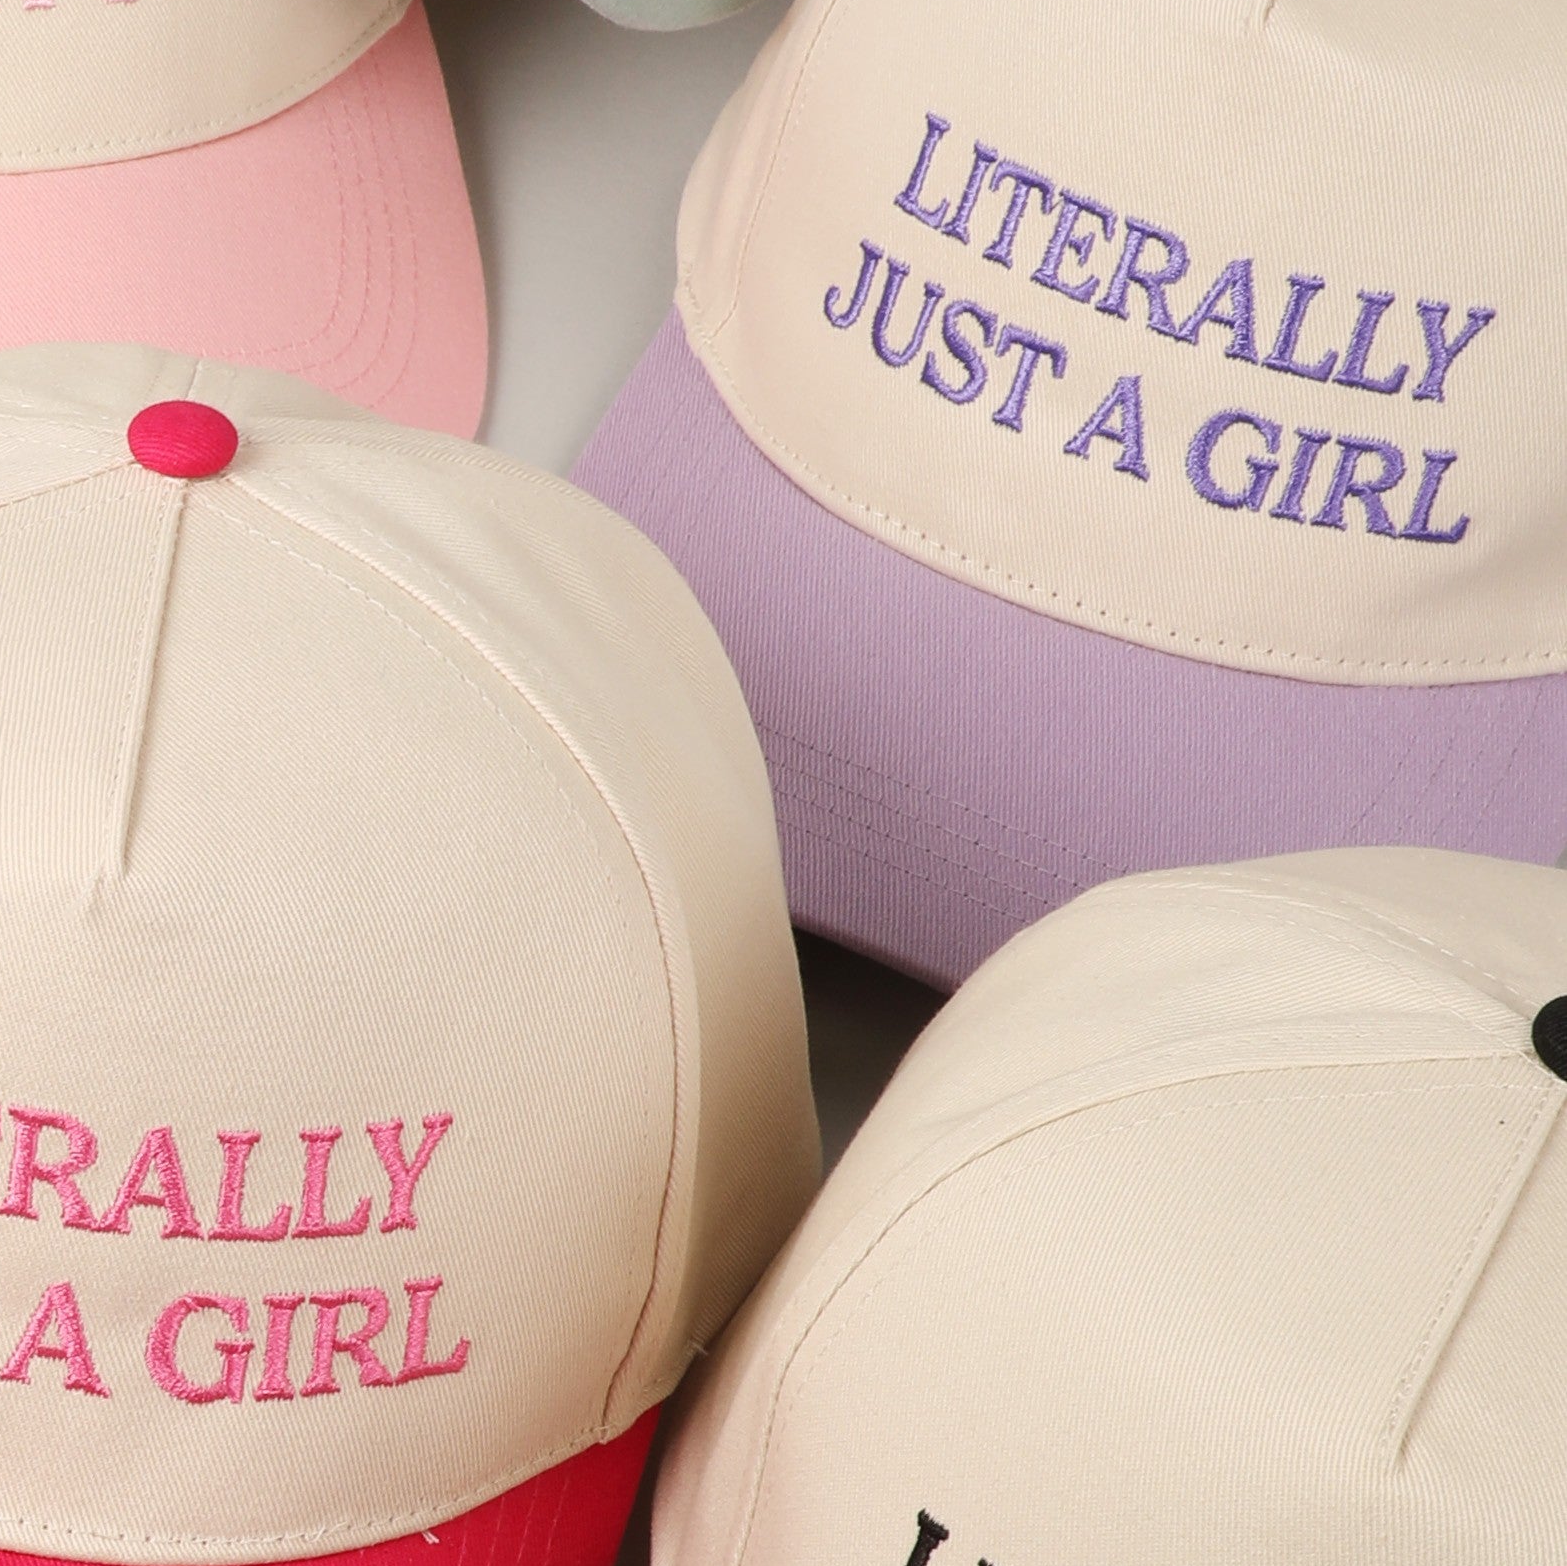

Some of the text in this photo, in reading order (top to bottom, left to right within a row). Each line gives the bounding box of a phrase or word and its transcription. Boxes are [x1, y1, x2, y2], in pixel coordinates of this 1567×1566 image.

[822, 238, 1471, 544] JUST A GIRL
[893, 110, 1497, 403] LITERALLY
[145, 1275, 472, 1405] GIRL
